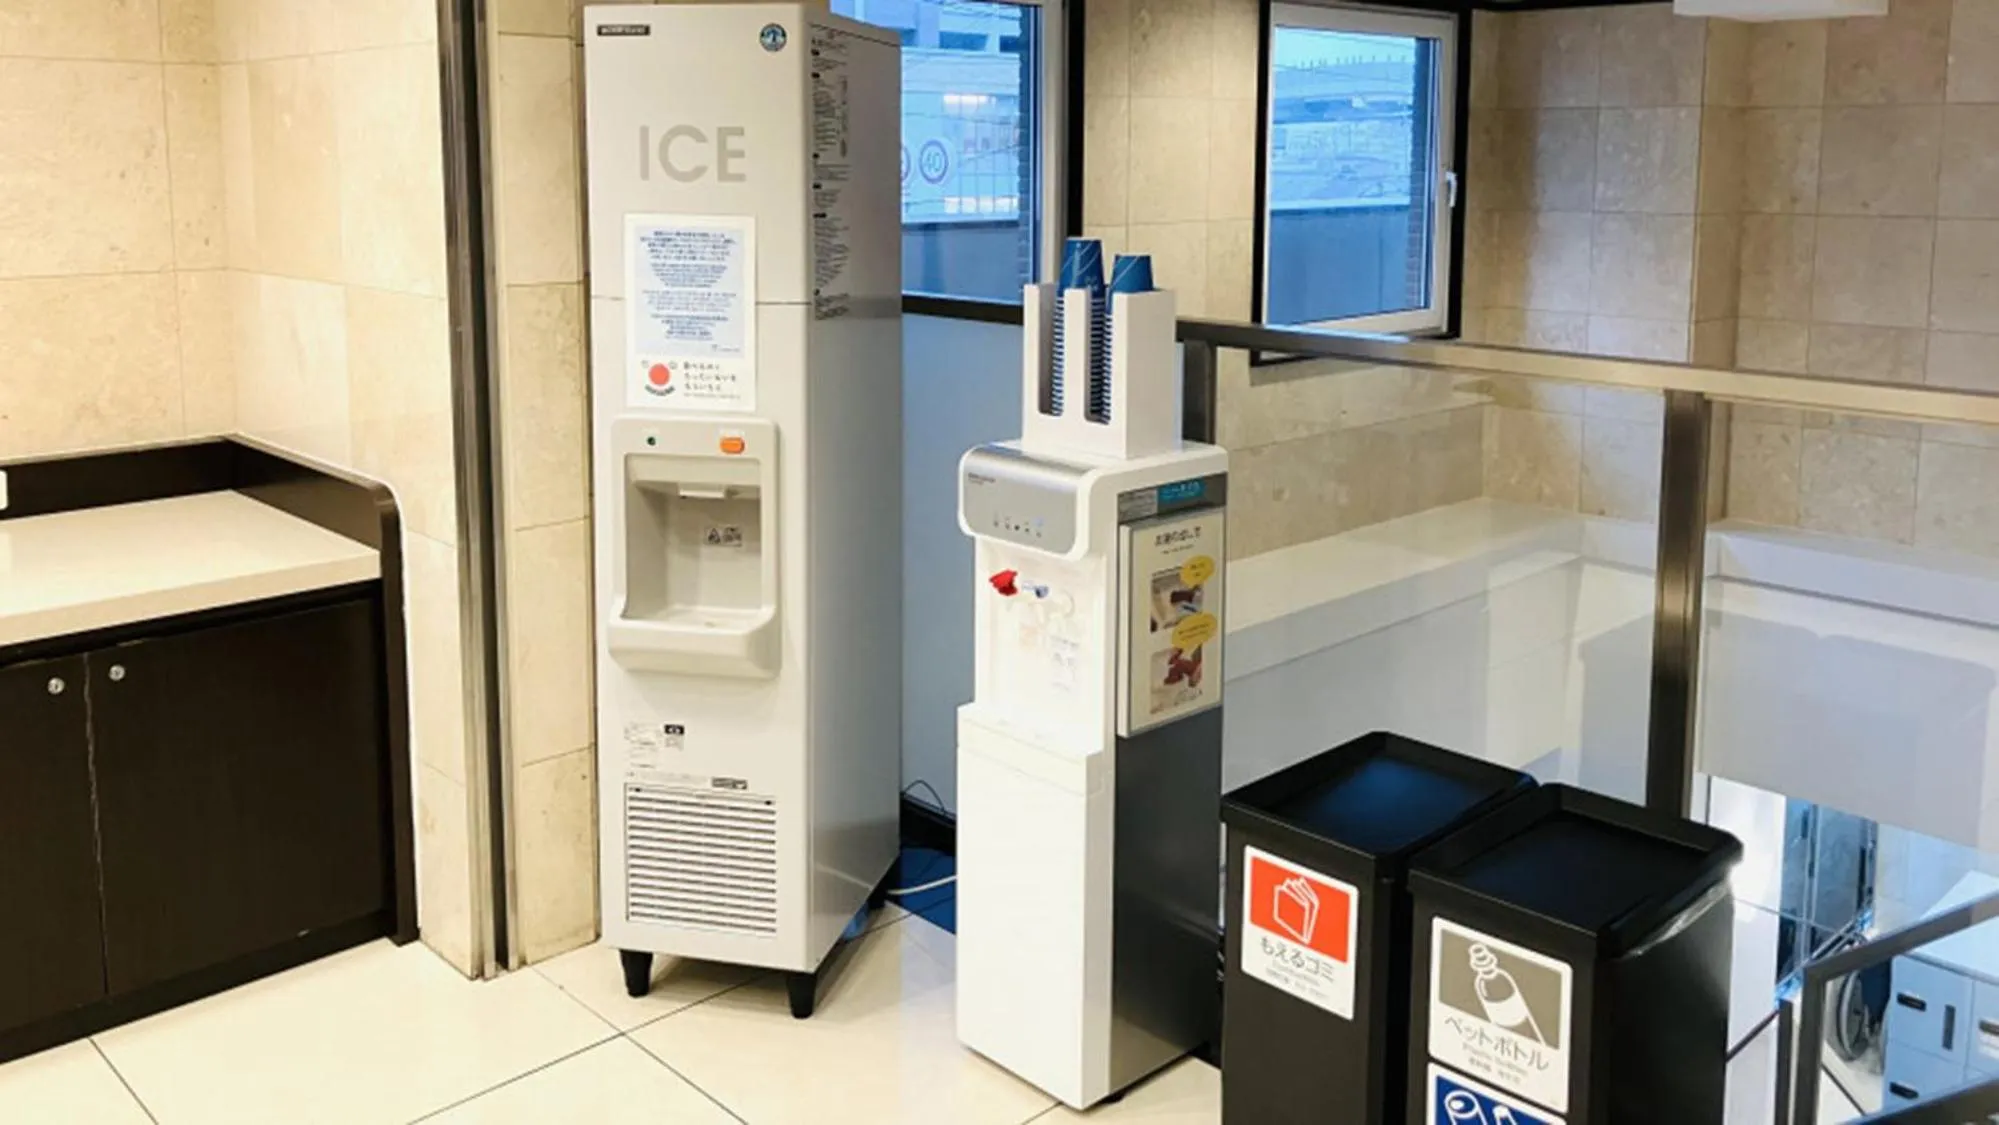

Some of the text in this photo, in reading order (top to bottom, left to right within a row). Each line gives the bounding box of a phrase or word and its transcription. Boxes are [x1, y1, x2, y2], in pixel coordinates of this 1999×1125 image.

[639, 124, 747, 183] ICE
[923, 151, 942, 172] 40
[1260, 936, 1335, 983] もえるゴミ
[1444, 1016, 1549, 1071] ペットボトル
